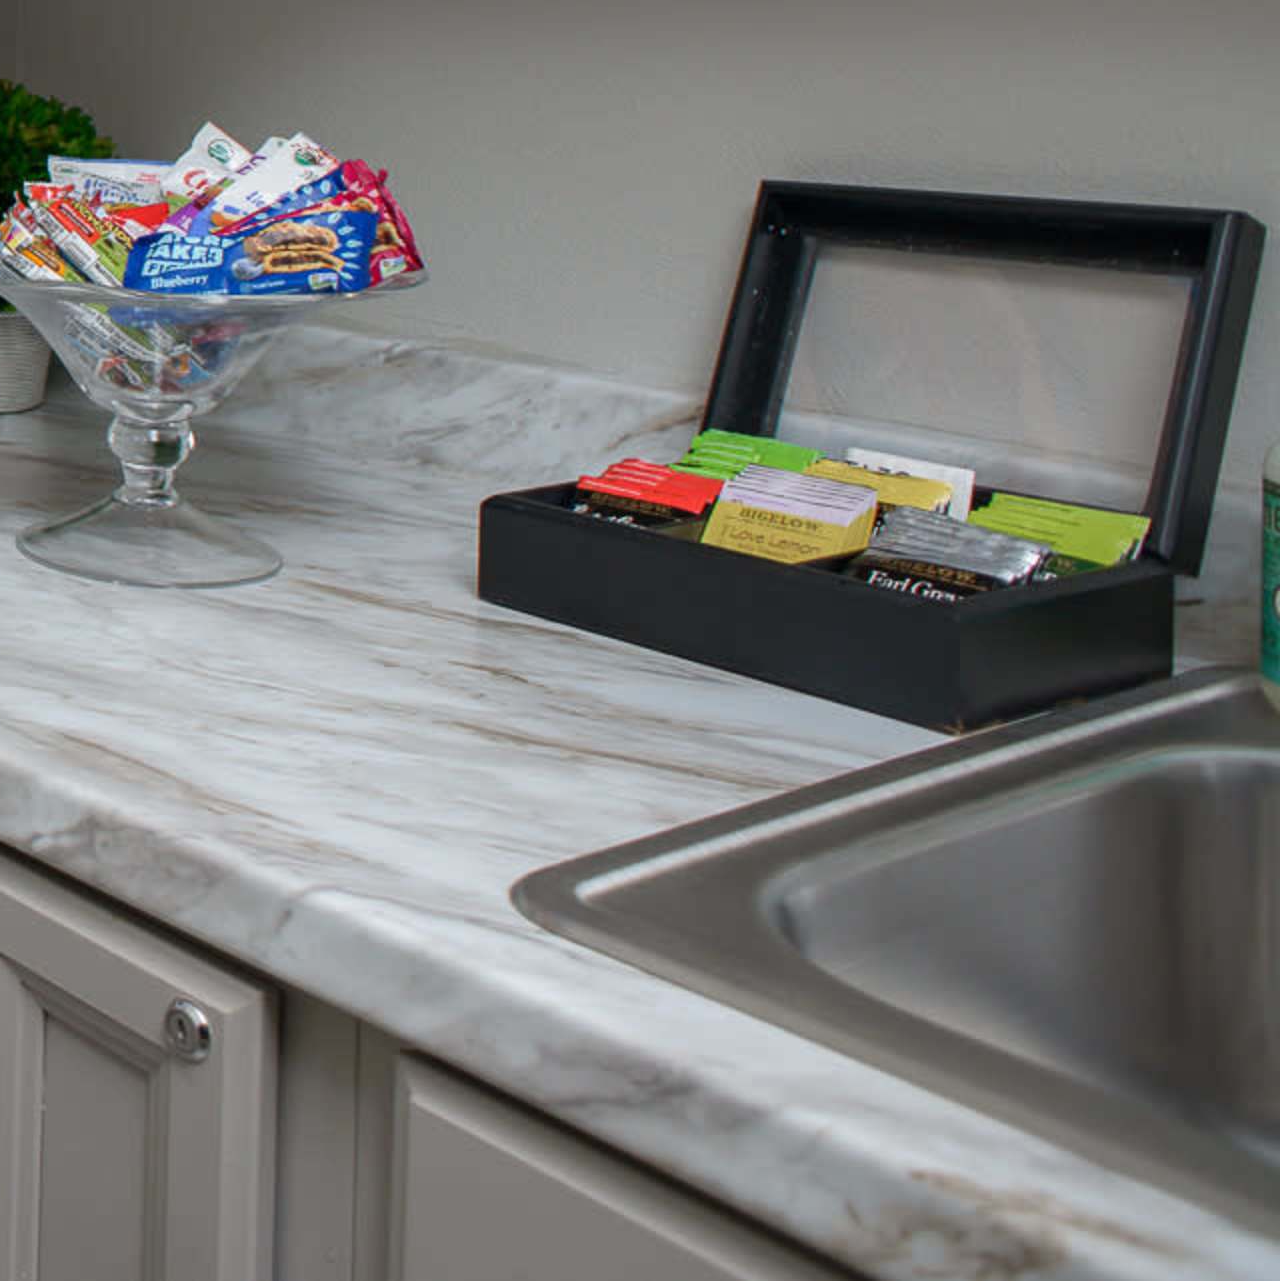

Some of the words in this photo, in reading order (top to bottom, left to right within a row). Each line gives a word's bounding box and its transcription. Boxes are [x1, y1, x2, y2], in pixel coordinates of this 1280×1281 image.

[150, 273, 209, 289] Blueberry
[739, 506, 819, 532] BIGELOW
[766, 533, 821, 555] Lemon
[867, 568, 912, 593] Earl
